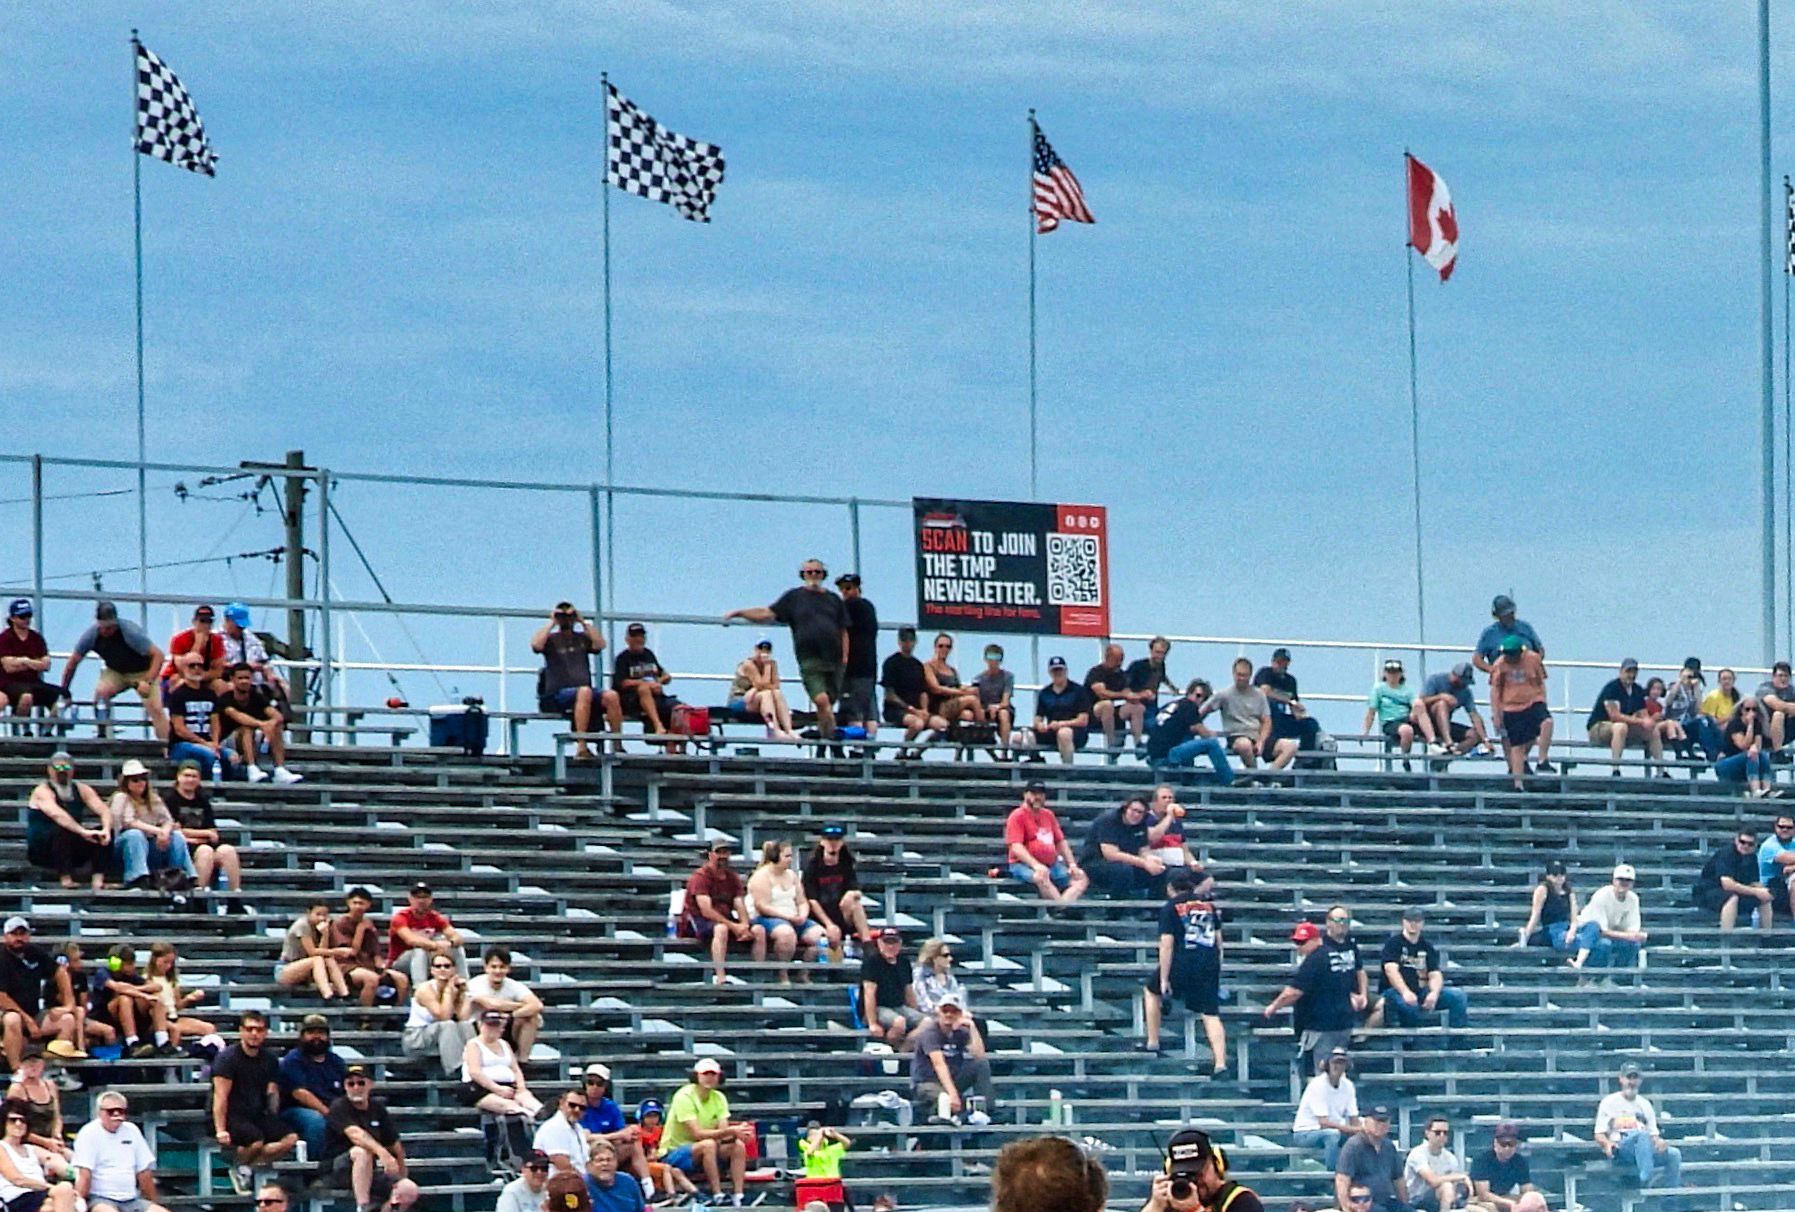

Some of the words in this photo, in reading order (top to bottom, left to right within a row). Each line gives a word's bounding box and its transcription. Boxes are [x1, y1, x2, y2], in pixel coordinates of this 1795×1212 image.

[921, 529, 968, 552] SCAN
[971, 531, 993, 553] TO
[998, 533, 1036, 556] JOIN
[923, 554, 957, 577] THE
[959, 555, 996, 578] TMP
[923, 578, 1042, 605] NEWSLETTER.
